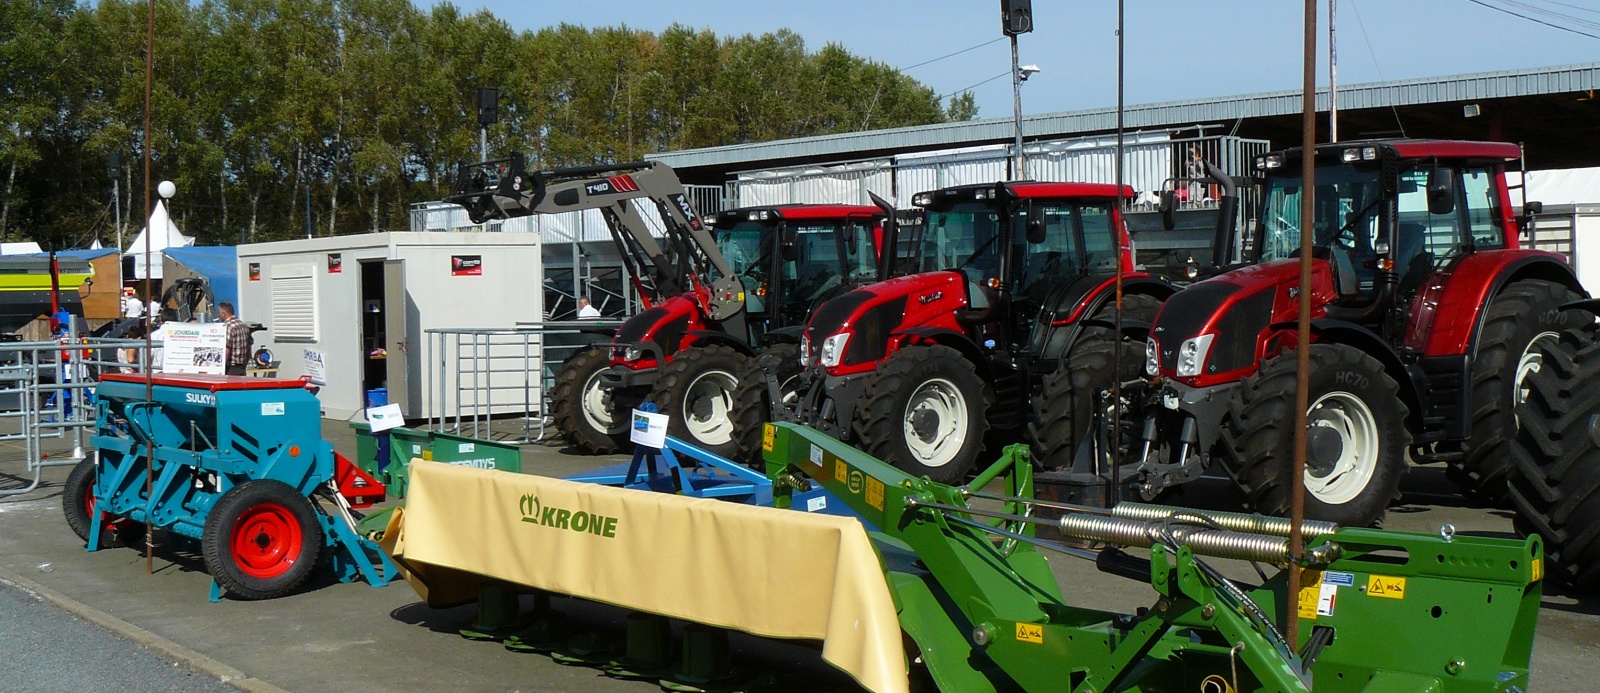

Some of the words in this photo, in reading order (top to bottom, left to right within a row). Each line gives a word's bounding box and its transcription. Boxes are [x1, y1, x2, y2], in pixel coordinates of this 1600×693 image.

[586, 182, 609, 194] T410
[677, 194, 696, 221] MX
[1335, 371, 1370, 390] HC70
[186, 393, 212, 405] SULKY
[540, 506, 619, 539] KRONE
